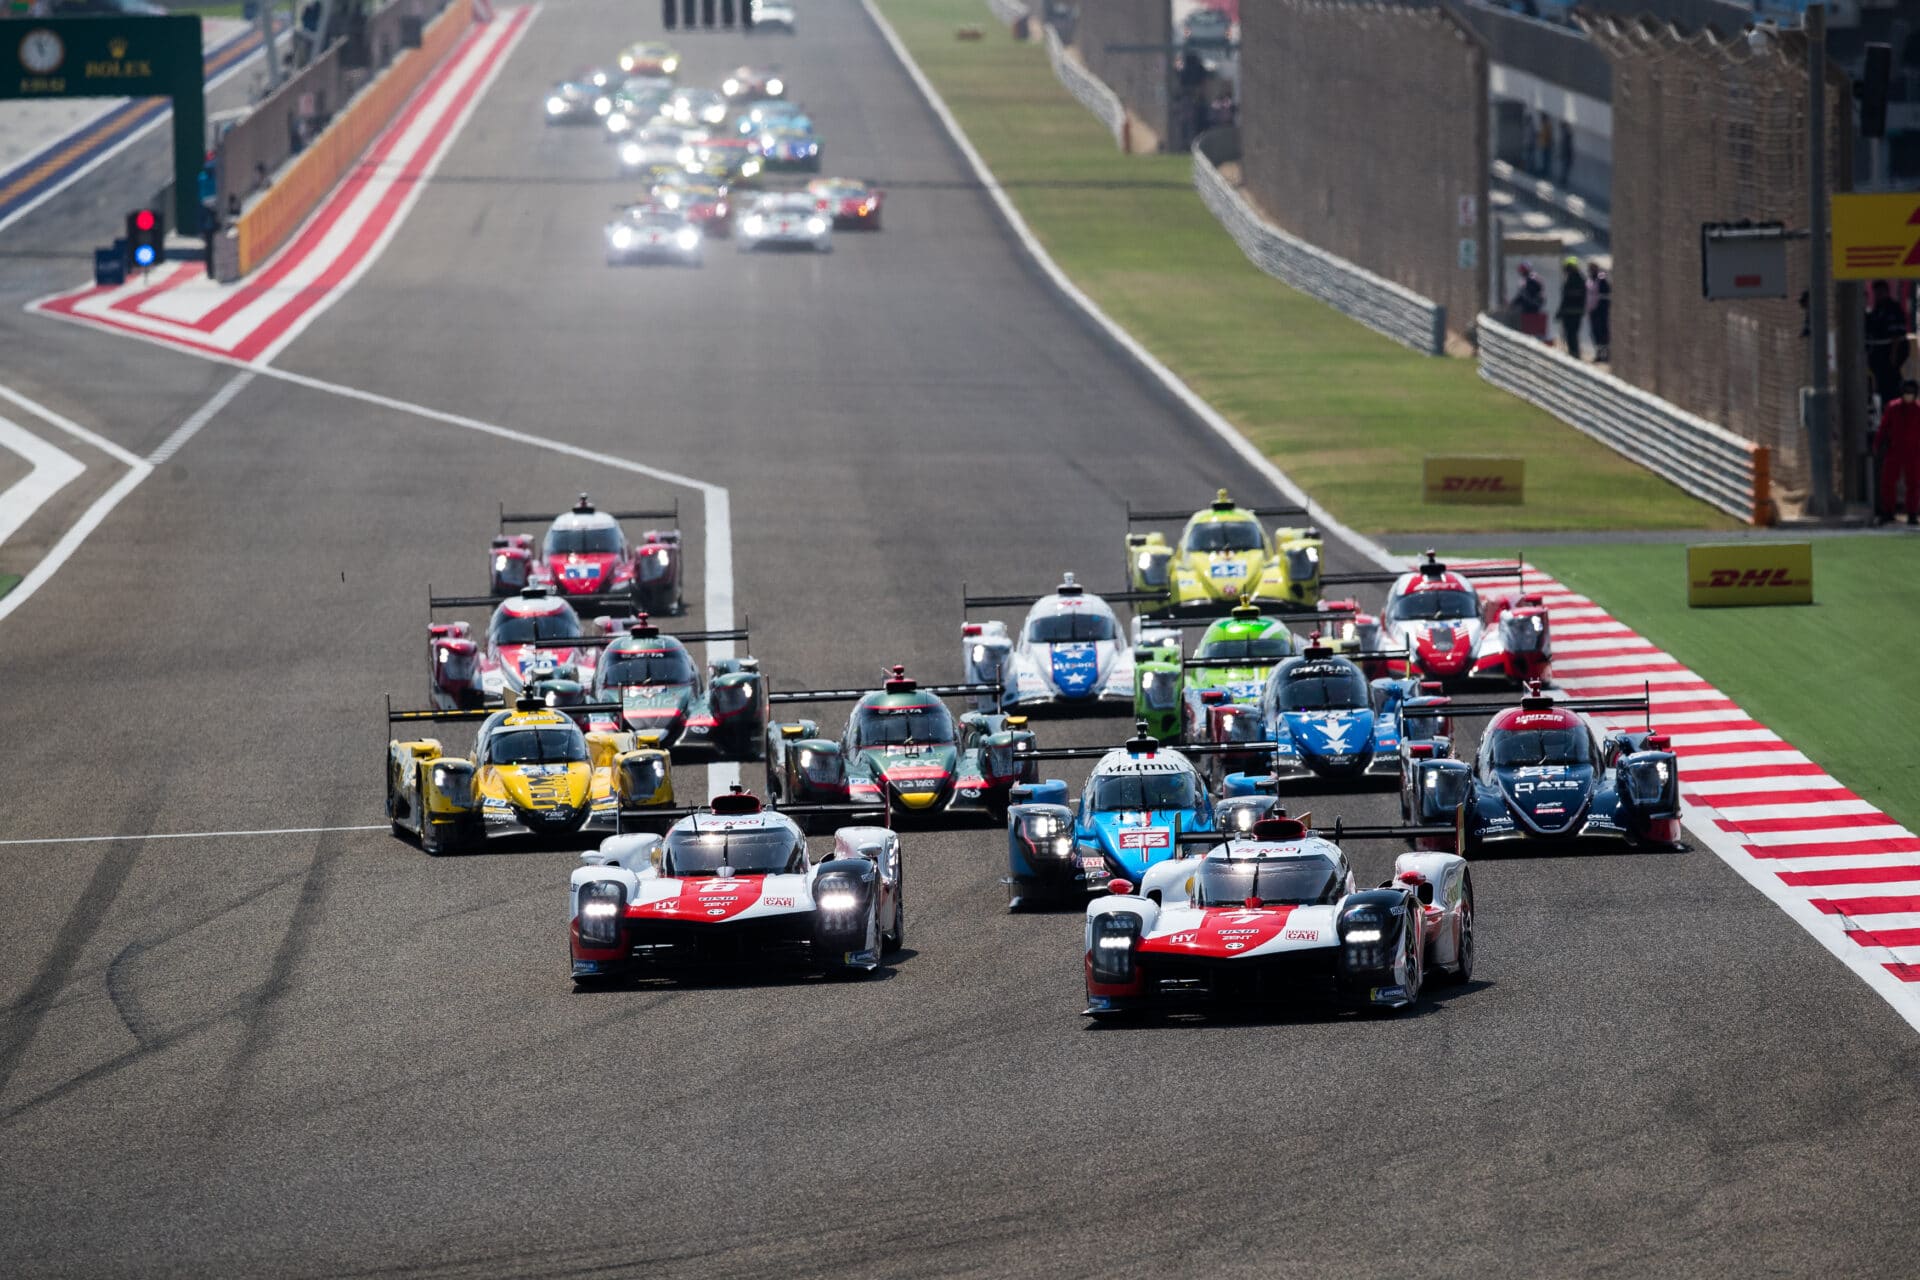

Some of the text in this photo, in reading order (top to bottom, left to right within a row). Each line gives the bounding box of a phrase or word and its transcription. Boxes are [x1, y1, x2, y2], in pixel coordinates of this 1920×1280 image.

[85, 61, 152, 78] ROLEX
[1441, 475, 1504, 492] DHL
[1709, 568, 1793, 587] DHL
[1231, 683, 1265, 697] 34
[890, 759, 940, 768] KFC
[1106, 763, 1181, 775] Matmut
[655, 901, 676, 909] HY
[1171, 934, 1195, 943] HY
